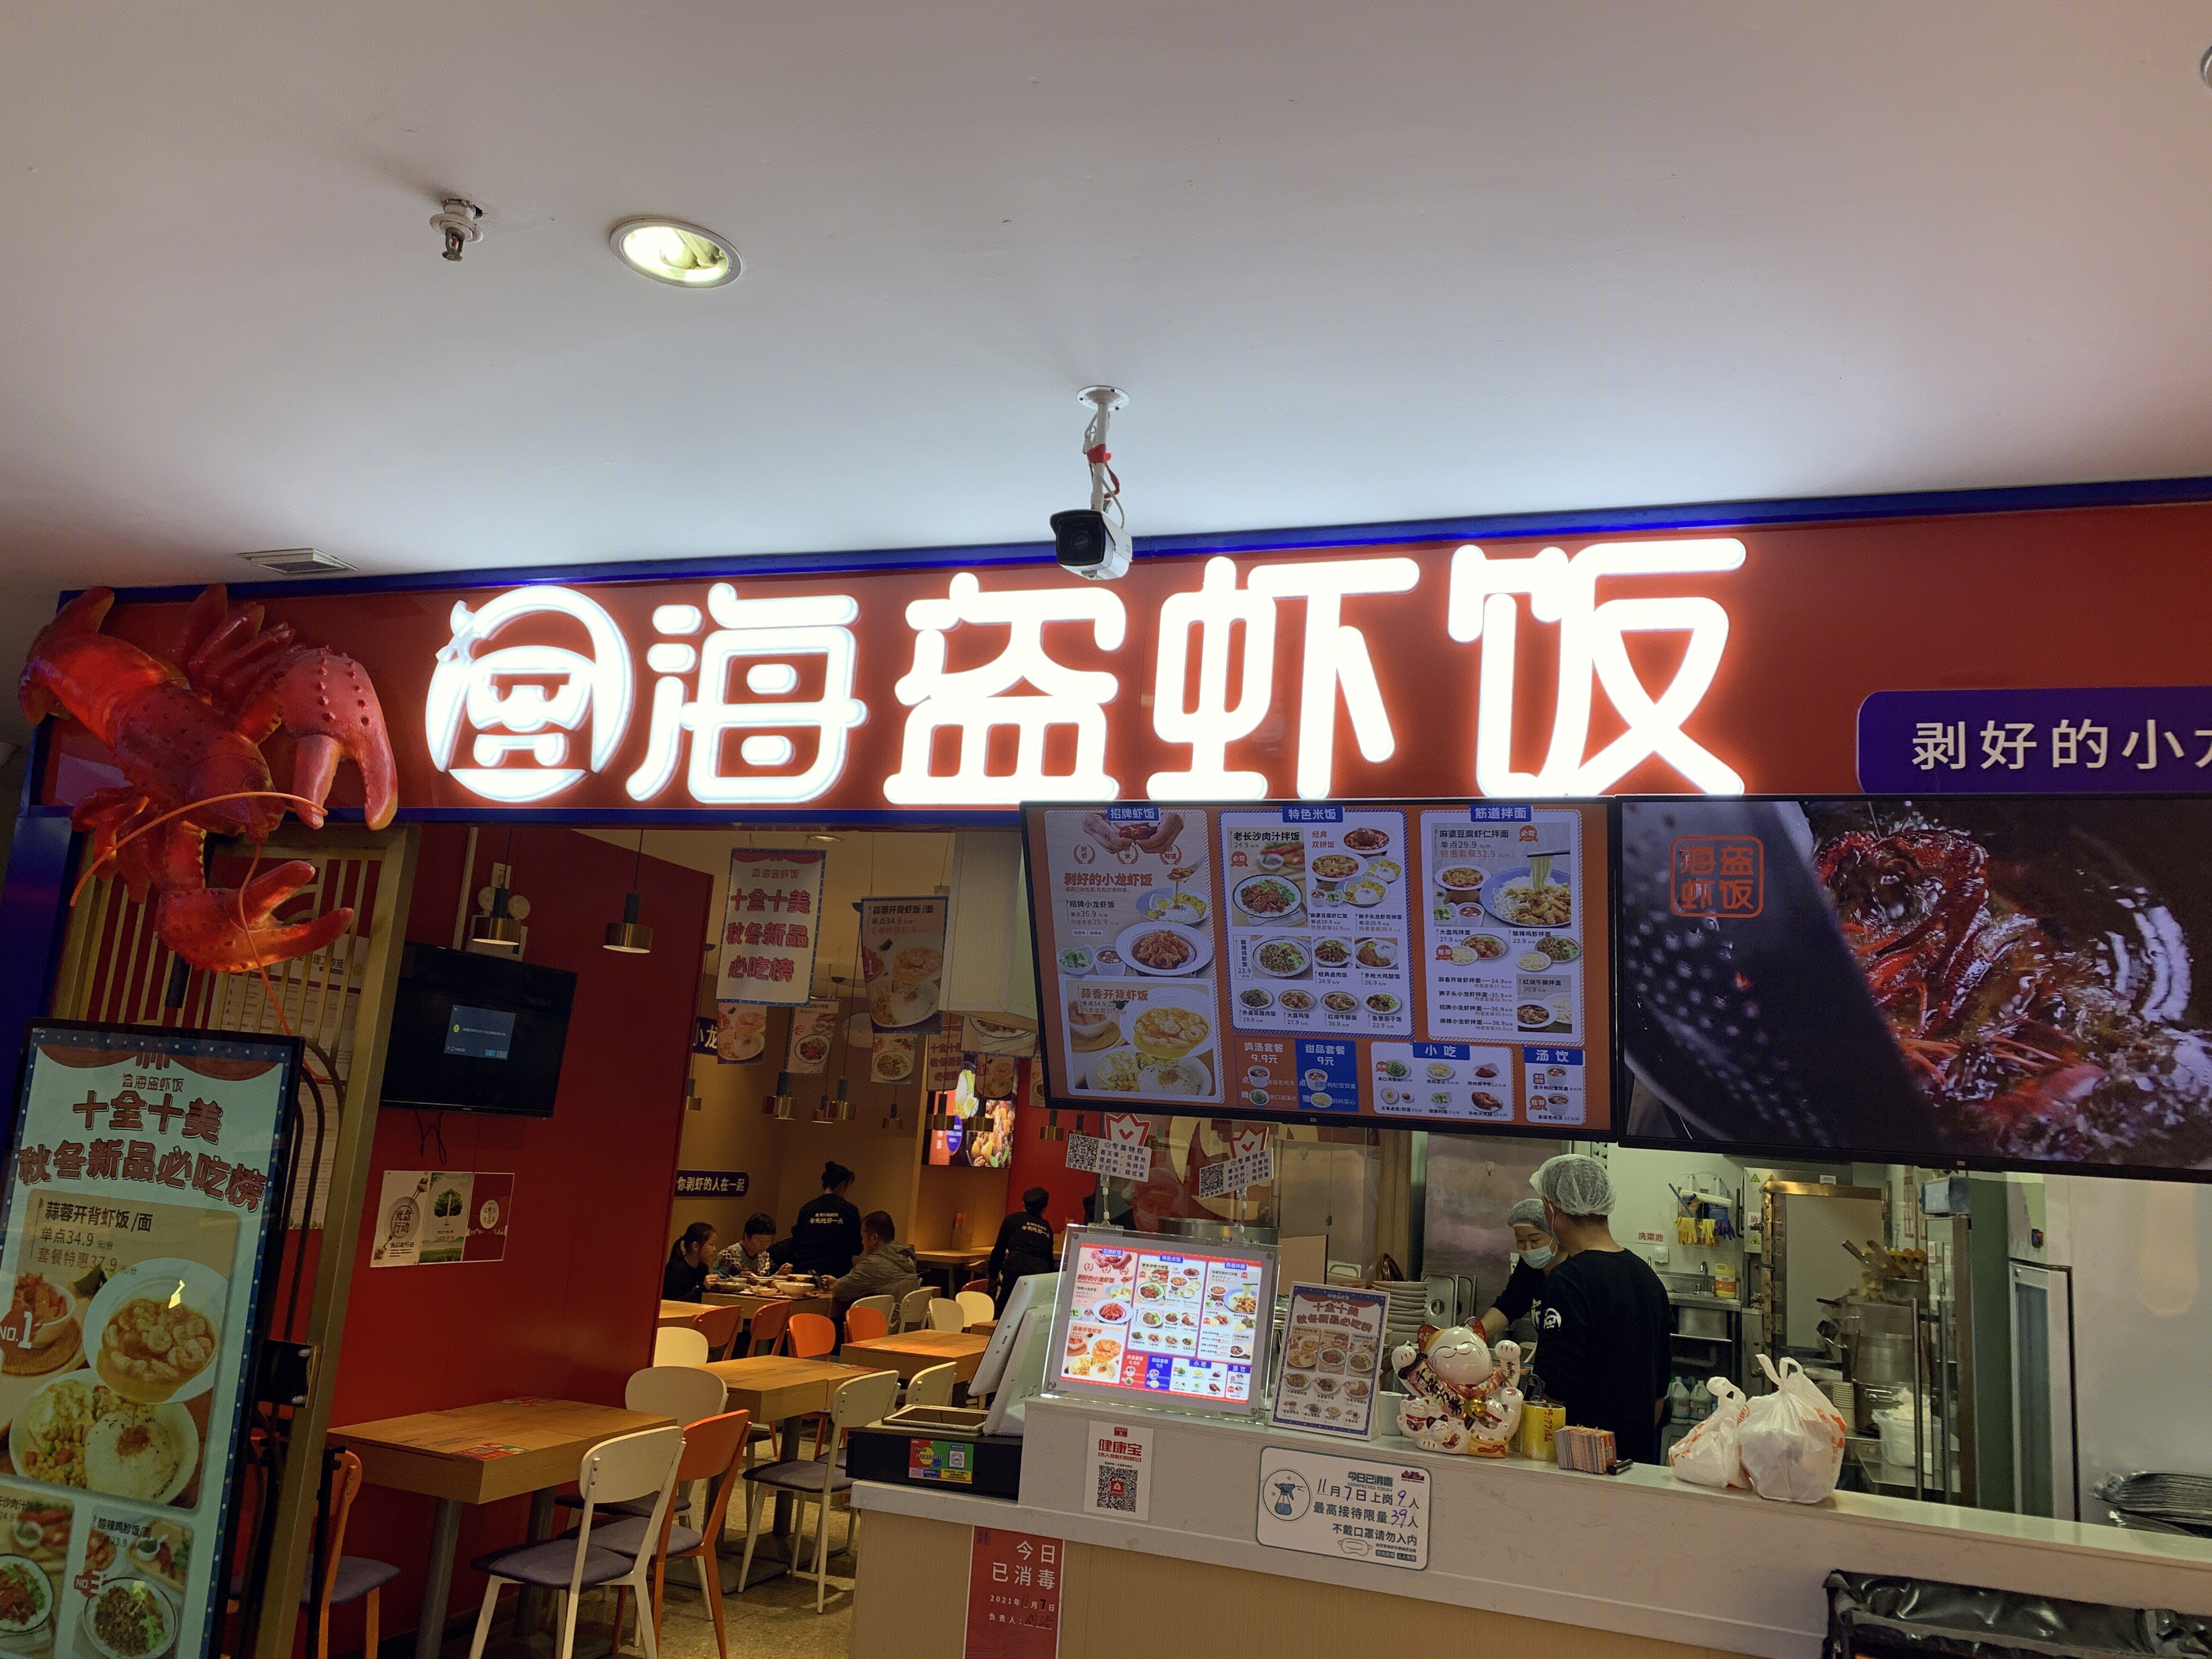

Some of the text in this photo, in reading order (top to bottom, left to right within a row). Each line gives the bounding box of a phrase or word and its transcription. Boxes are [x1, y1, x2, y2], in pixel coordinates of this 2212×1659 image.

[627, 538, 1746, 805] 海盗虾饭
[1110, 808, 1154, 820] 招牌虾饭
[1289, 809, 1336, 820] 特色米饭
[1475, 807, 1527, 819] 筋道拌面
[1233, 831, 1300, 841] 老长沙肉汁拌饭
[1440, 830, 1509, 838] 麻婆豆腐虾仁拌面
[1679, 844, 1754, 875] 海盗
[1064, 873, 1153, 886] 剥好的小龙虾饭
[730, 888, 811, 915] 十全十美
[1680, 879, 1753, 910] 虾饭
[726, 922, 809, 948] 秋冬新品
[727, 955, 795, 982] 必吃榜
[1244, 1042, 1283, 1053] 鸡汤套餐
[1305, 1044, 1345, 1056] 甜品套餐
[1425, 1045, 1458, 1058] 小吃
[1251, 1054, 1278, 1064] 9.9元
[1317, 1056, 1334, 1066] 9元
[1536, 1049, 1569, 1063] 汤饮
[134, 1074, 184, 1093] 海盗虾饭
[72, 1090, 224, 1145] 十全十美
[1113, 1143, 1144, 1154] 专属特权
[18, 1138, 268, 1212] 秋冬新品必吃榜
[678, 1176, 745, 1192] 你剥虾的人在一起
[395, 1209, 412, 1221] 光盘
[393, 1222, 410, 1234] 行动
[40, 1226, 94, 1247] 单点34.9
[1638, 1232, 1663, 1242] 洗菜池
[37, 1247, 117, 1272] 套餐特惠37.9
[1312, 1302, 1359, 1317] 十全十美
[1098, 1439, 1142, 1457] 健康宝
[1348, 1471, 1394, 1487] 今日已消毒
[1332, 1523, 1418, 1547] 不戴口罩请勿入内
[1016, 1540, 1056, 1565] 今日
[992, 1562, 1055, 1590] 已消毒
